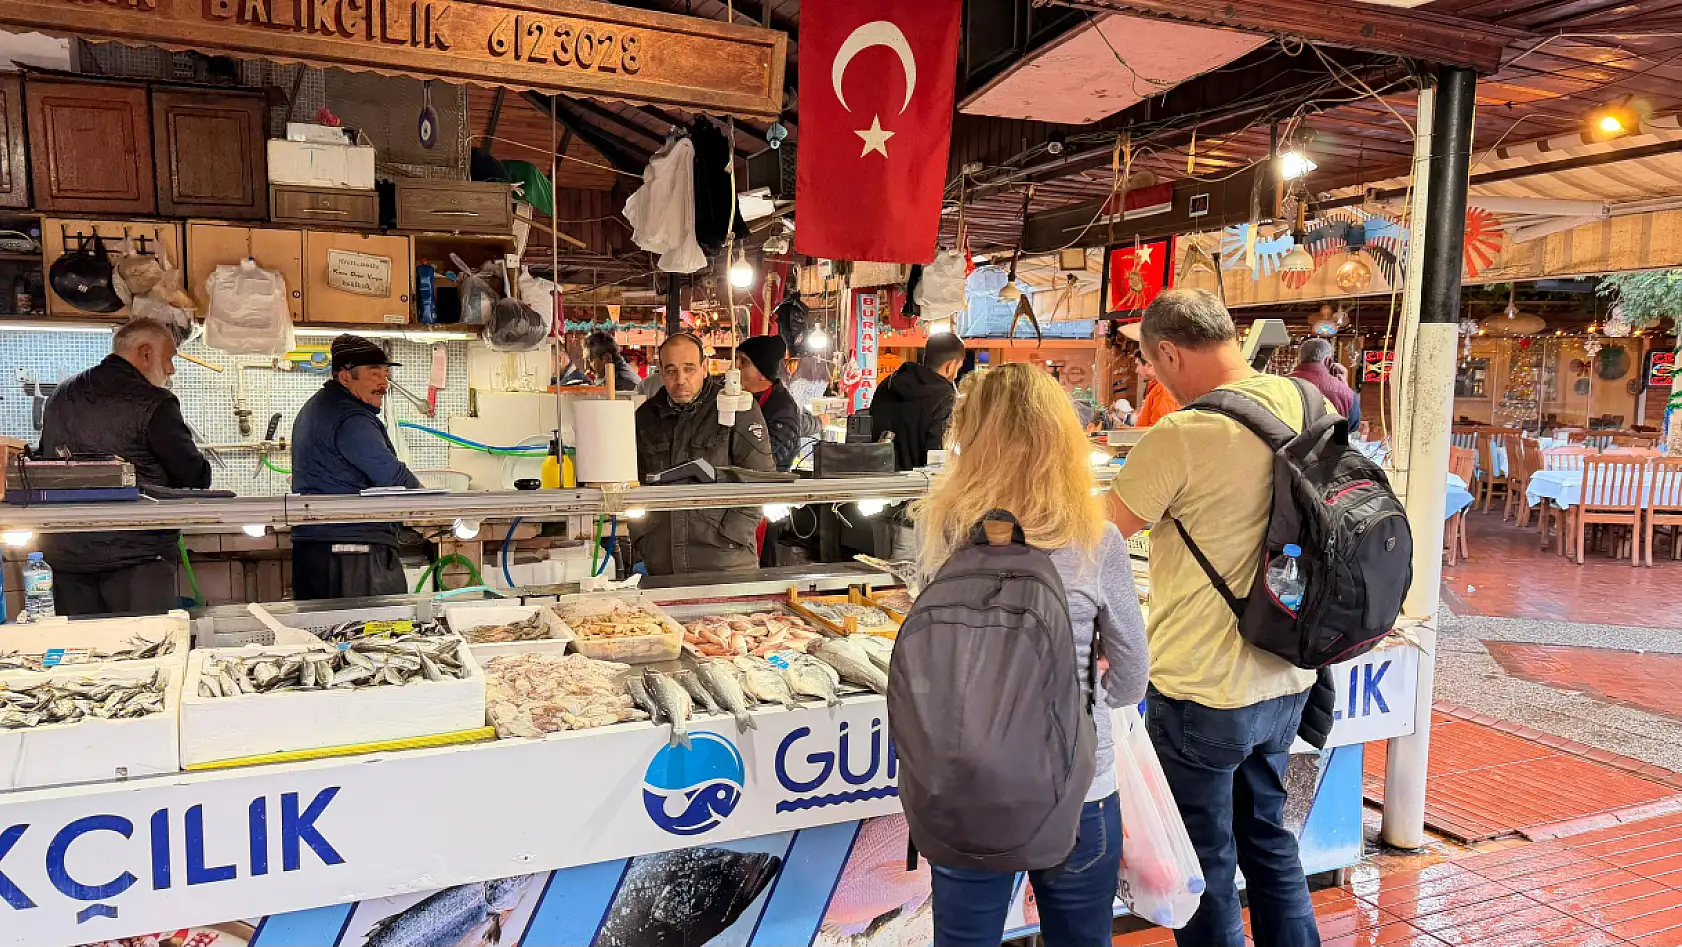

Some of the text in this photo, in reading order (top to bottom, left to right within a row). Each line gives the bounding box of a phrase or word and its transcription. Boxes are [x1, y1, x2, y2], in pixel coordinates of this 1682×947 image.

[488, 14, 642, 75] 6123028
[861, 297, 874, 353] BURAK
[1333, 659, 1393, 720] IK
